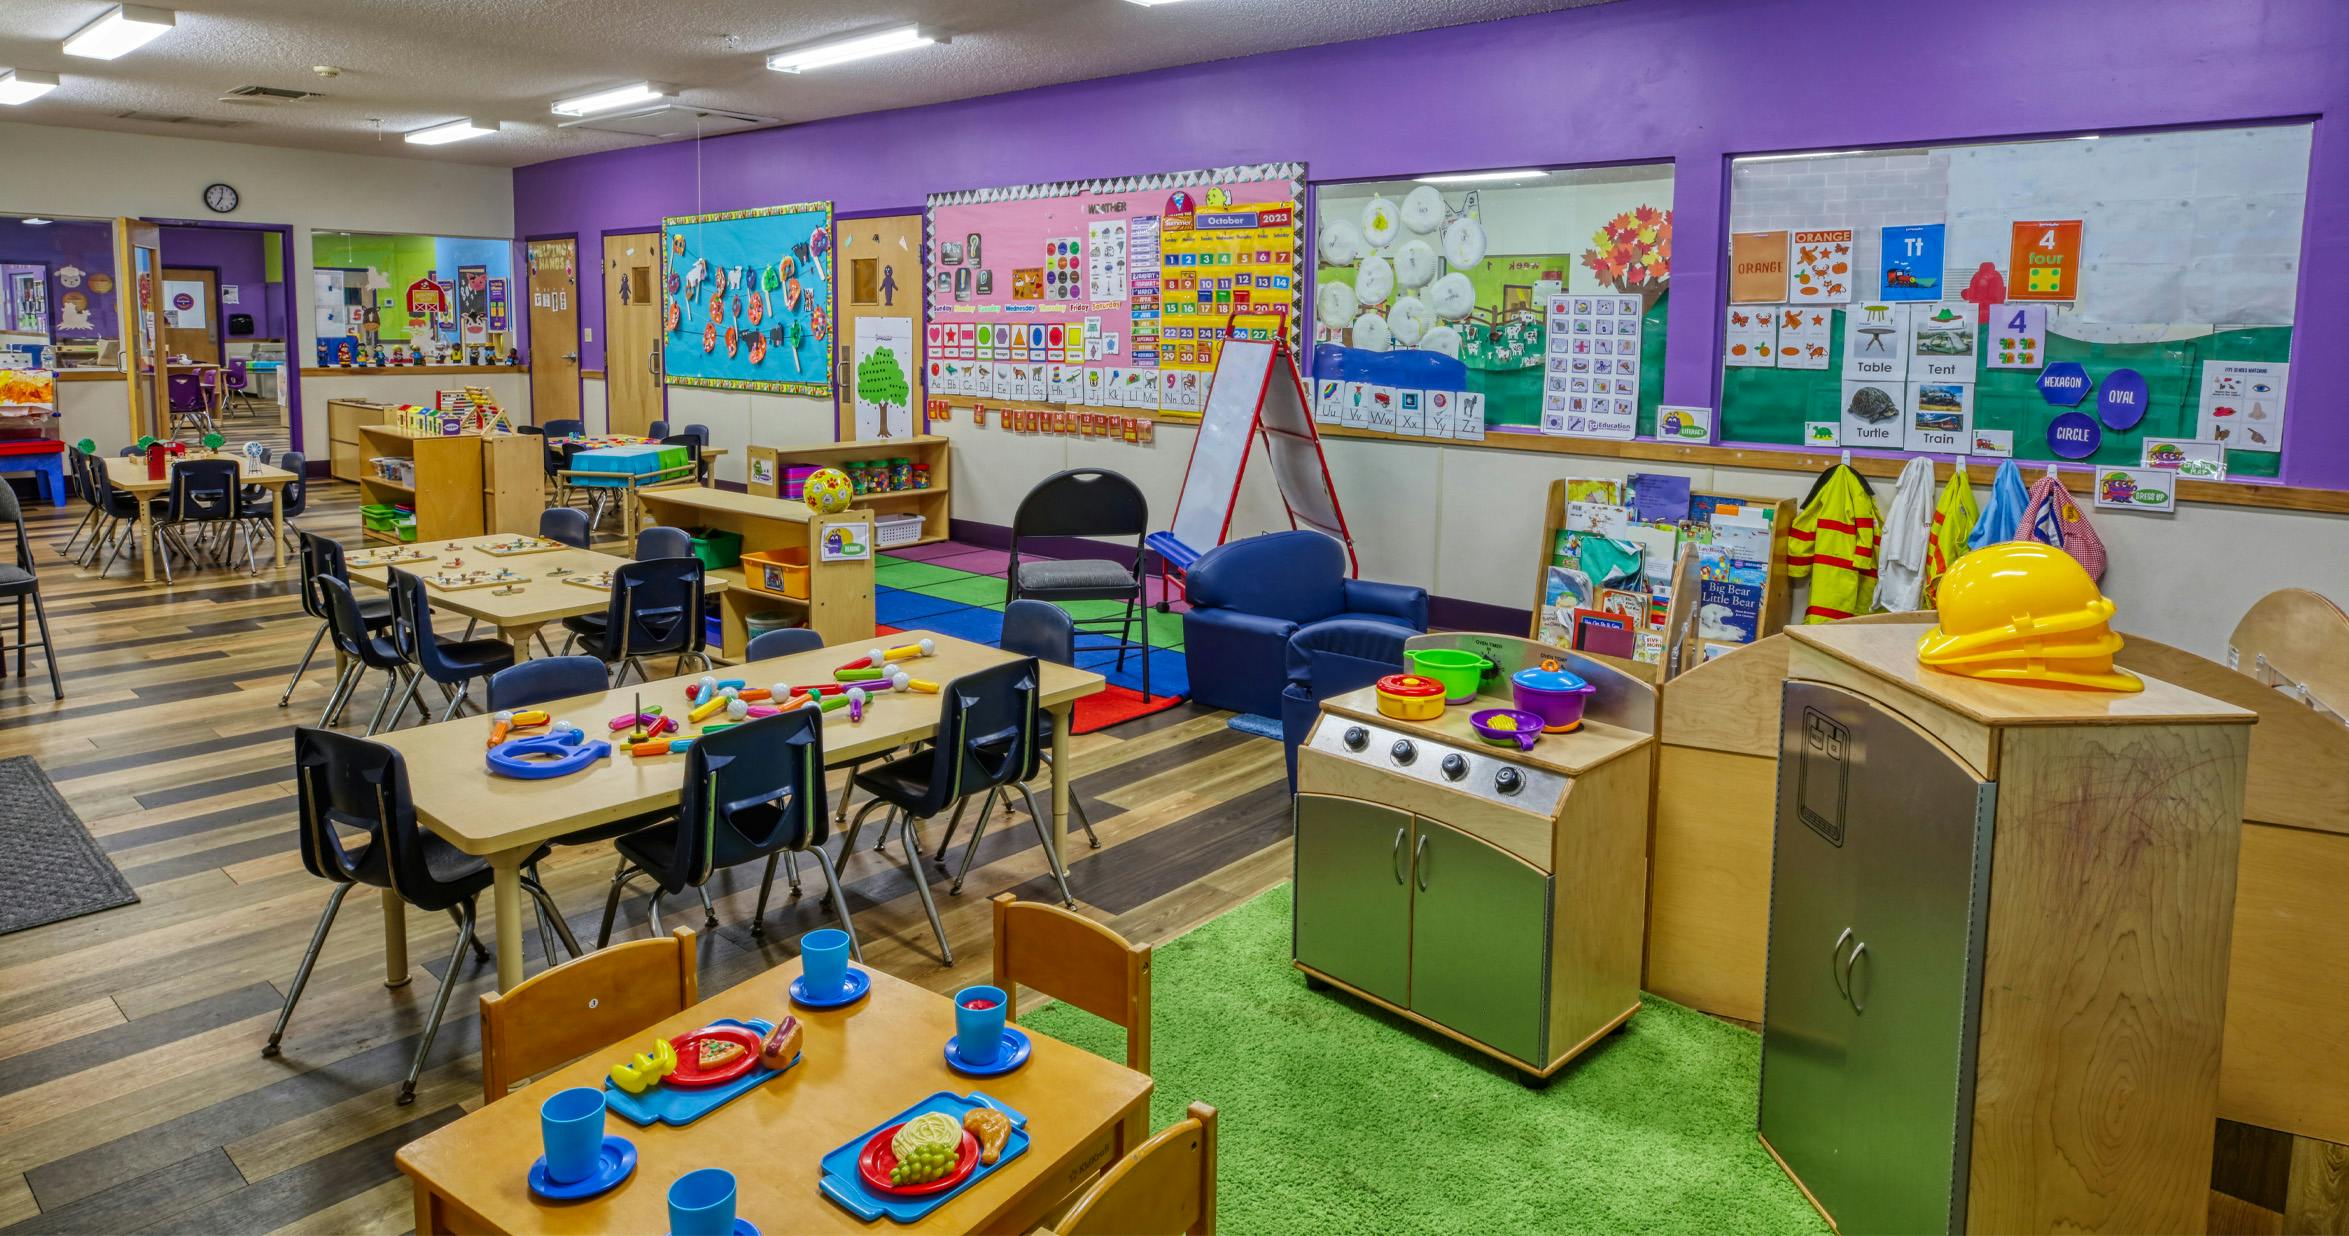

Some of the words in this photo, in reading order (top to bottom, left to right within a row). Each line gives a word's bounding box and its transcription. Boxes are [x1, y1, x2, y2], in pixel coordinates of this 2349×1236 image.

[1208, 217, 1244, 225] October
[1263, 214, 1288, 223] 2023
[1796, 231, 1851, 243] ORANGE
[2039, 229, 2056, 250] 4
[1904, 237, 1924, 257] Tt
[1169, 256, 1175, 264] 1
[1185, 256, 1192, 264] 2
[1203, 255, 1210, 263] 3
[1221, 255, 1228, 263] 4
[1260, 253, 1266, 261] 6
[2029, 252, 2064, 265] four
[1738, 261, 1784, 274] ORANGE
[1169, 281, 1175, 289] 8
[1185, 281, 1191, 289] 9
[1201, 280, 1212, 289] 10
[1220, 280, 1229, 288] 11
[1238, 275, 1249, 283] 12
[1258, 278, 1268, 286] 13
[1276, 278, 1287, 287] 14
[1005, 304, 1035, 312] Wednesday
[1070, 304, 1088, 312] Friday
[1092, 302, 1121, 312] Saturday
[1166, 304, 1176, 312] 15
[1183, 304, 1193, 312] 16
[1201, 304, 1211, 313] 17
[1218, 305, 1228, 313] 18
[1237, 304, 1248, 312] 19
[2008, 310, 2027, 333] 4
[1164, 329, 1176, 337] 22
[1181, 329, 1193, 337] 23
[1200, 330, 1212, 338] 24
[1234, 330, 1247, 338] 26
[1253, 331, 1266, 339] 27
[1163, 352, 1175, 360] 29
[1181, 353, 1193, 361] 30
[1199, 354, 1209, 362] 31
[1858, 362, 1892, 373] Table
[1928, 364, 1955, 375] Tent
[2044, 377, 2081, 388] HEXAGON
[947, 380, 956, 389] Bb
[997, 384, 1006, 394] Ee
[1015, 384, 1024, 394] Ff
[1052, 385, 1063, 395] Hh
[1089, 389, 1099, 404] Jj
[1108, 390, 1118, 400] Kk
[1144, 392, 1157, 404] Mm
[1165, 393, 1177, 404] Nn
[2109, 390, 2135, 404] OVAL
[1323, 405, 1336, 417] Uu
[1350, 408, 1361, 420] Vv
[1370, 411, 1393, 425] Ww
[1403, 415, 1417, 429] Xx
[1433, 417, 1446, 435] Yy
[1462, 419, 1475, 433] Zz
[1598, 422, 1631, 430] Education
[1857, 428, 1889, 439] Turtle
[1924, 433, 1954, 444] Train
[2056, 427, 2090, 442] CIRCLE
[1709, 582, 1726, 594] Big
[1728, 584, 1751, 596] Bear
[1702, 592, 1730, 604] Little
[1732, 596, 1755, 608] Bear
